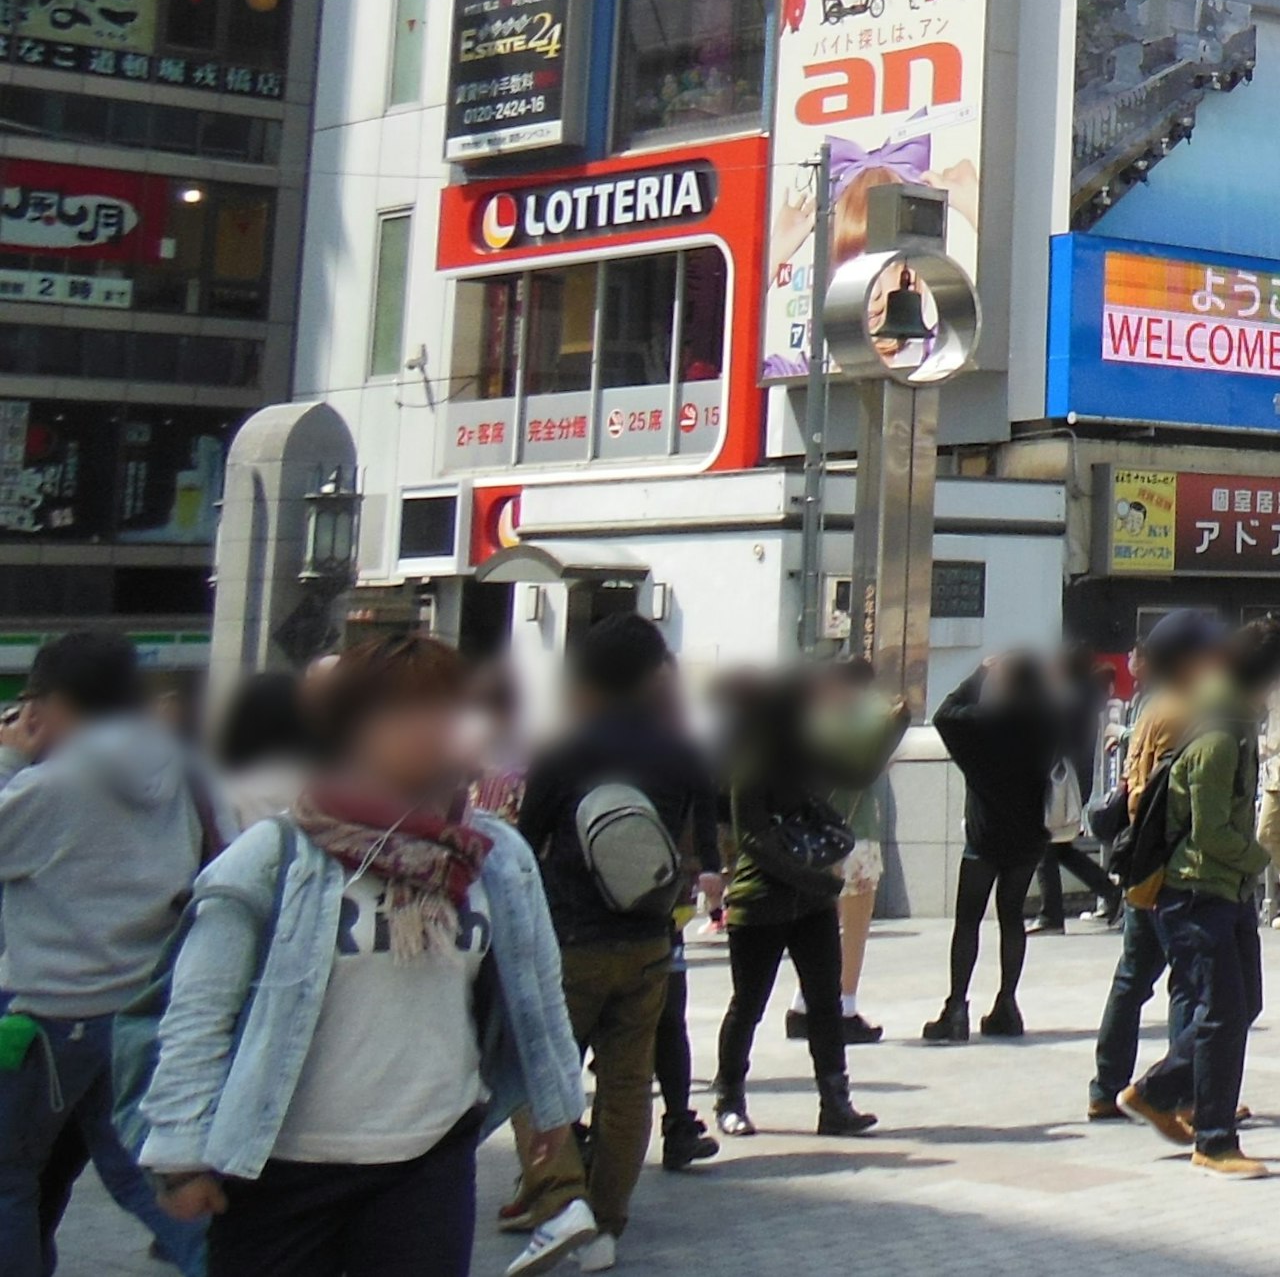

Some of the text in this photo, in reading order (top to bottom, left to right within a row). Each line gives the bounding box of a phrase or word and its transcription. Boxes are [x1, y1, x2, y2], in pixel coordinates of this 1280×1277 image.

[812, 16, 951, 58] バイト探しは、アン
[794, 40, 963, 126] an
[523, 168, 703, 238] LOTTERIA
